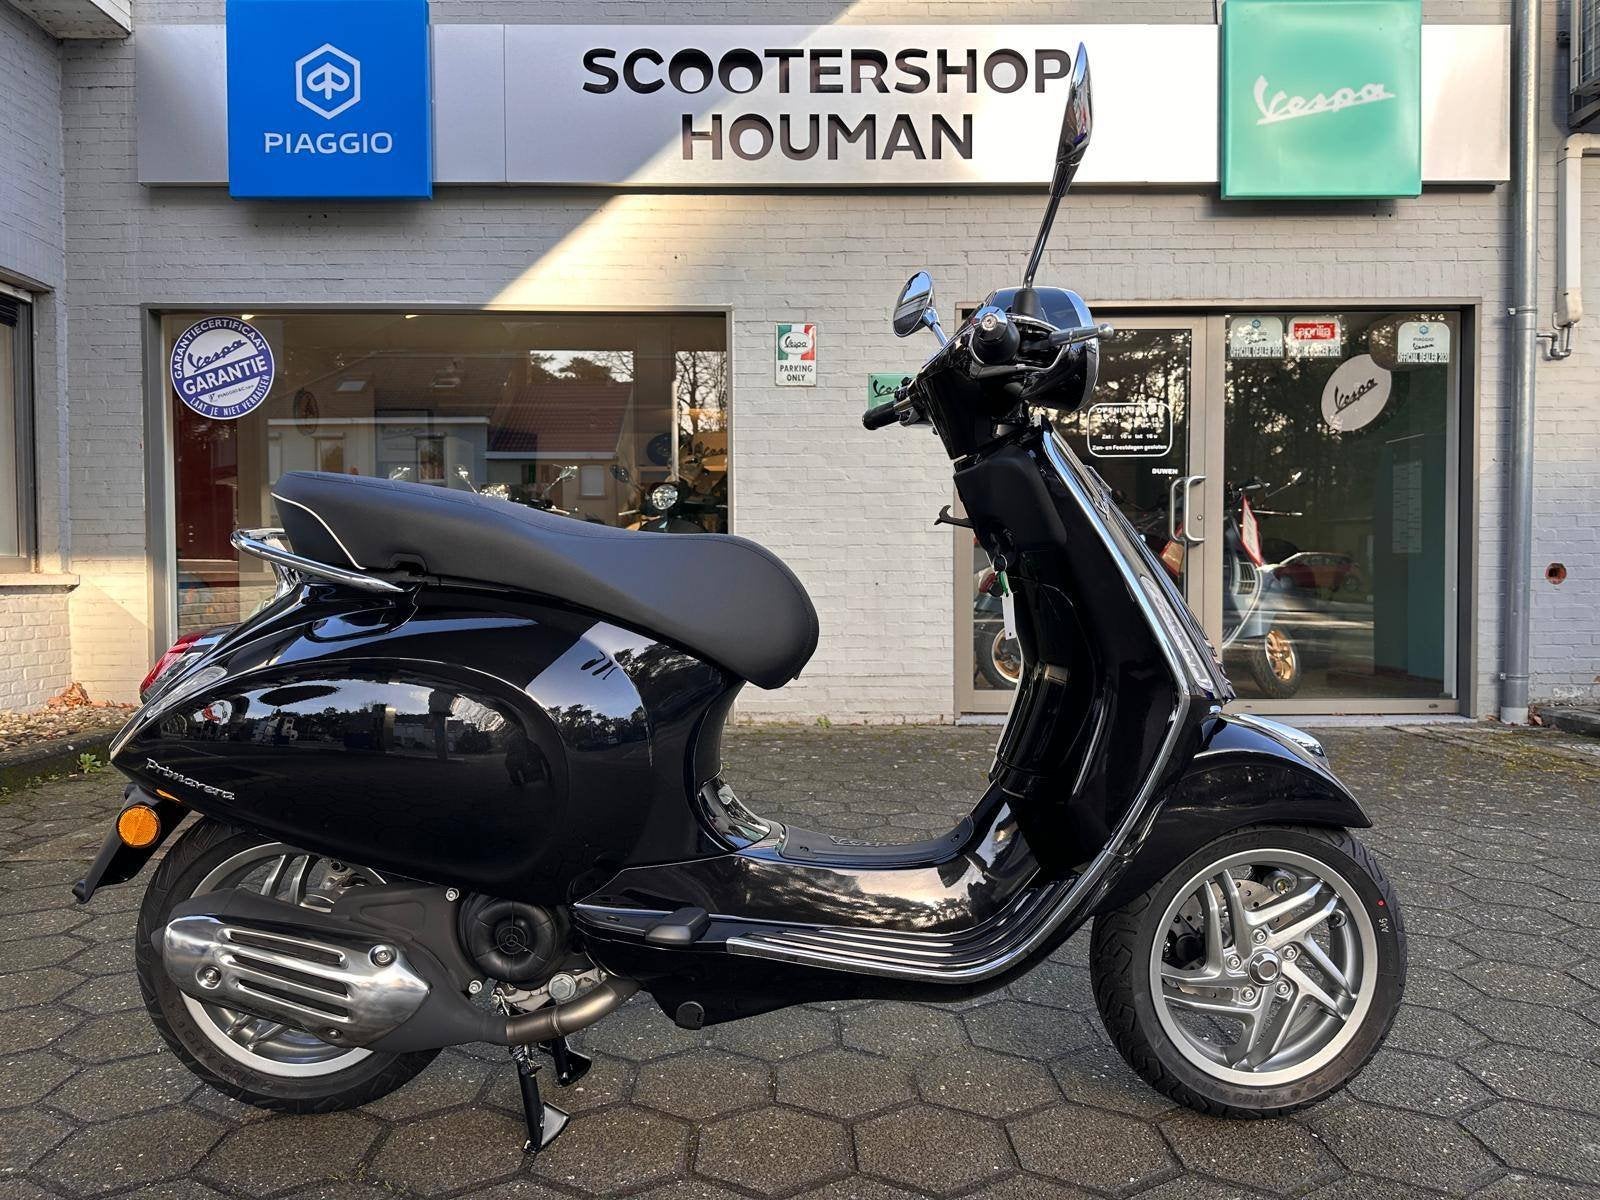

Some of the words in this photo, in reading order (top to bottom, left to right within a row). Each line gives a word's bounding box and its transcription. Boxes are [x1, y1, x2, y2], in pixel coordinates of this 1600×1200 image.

[582, 47, 1072, 94] SCOOTERSHOP
[1253, 74, 1396, 125] Vespa
[264, 132, 393, 154] PIAGGIO
[681, 113, 973, 160] HOUMAN
[174, 319, 267, 379] GARANTIECERTIFICAAT
[784, 335, 808, 348] Vespa
[1298, 325, 1332, 338] aprilia
[183, 355, 268, 395] GARANTIE
[187, 339, 248, 373] Vespa
[779, 364, 813, 373] PARKING
[190, 397, 207, 412] LAAT
[210, 407, 219, 416] JE
[223, 405, 241, 416] NIET
[242, 374, 270, 410] VERRASSEN
[786, 374, 806, 382] ONLY
[1334, 378, 1379, 414] Vespa
[146, 757, 235, 800] Primavera
